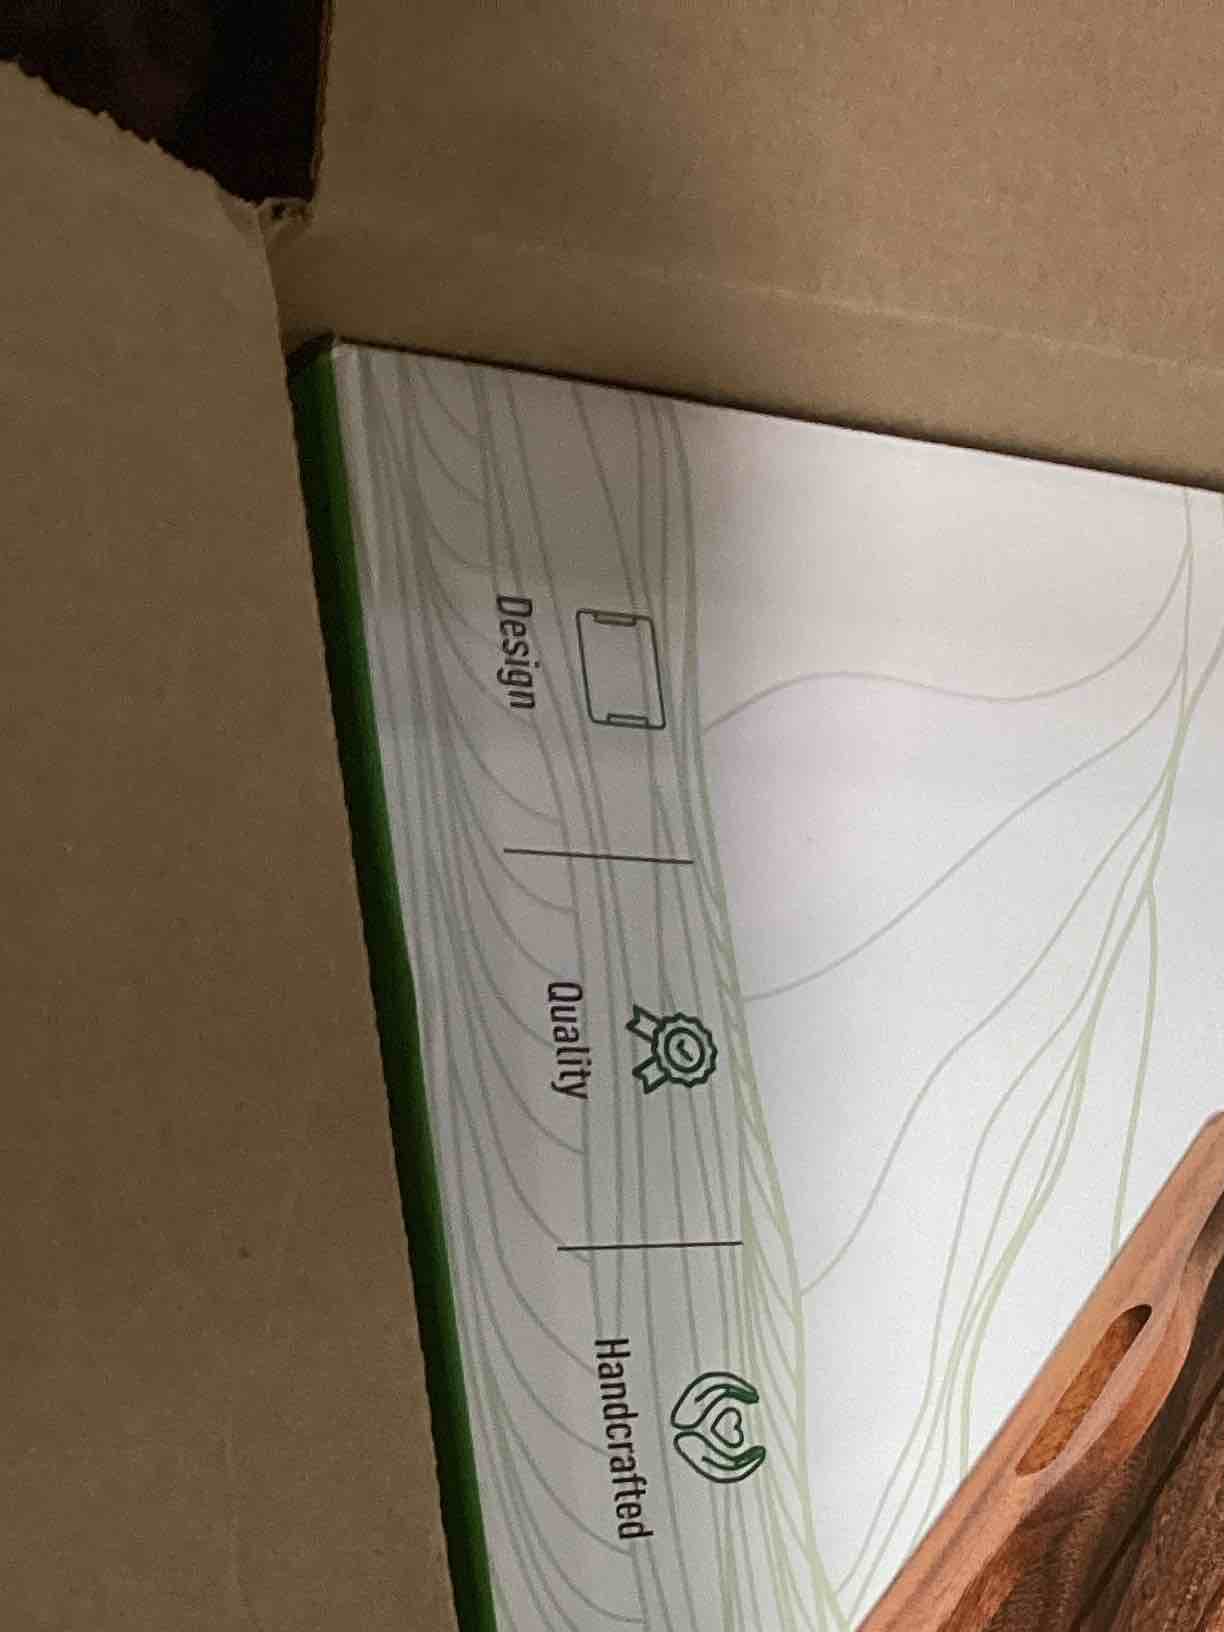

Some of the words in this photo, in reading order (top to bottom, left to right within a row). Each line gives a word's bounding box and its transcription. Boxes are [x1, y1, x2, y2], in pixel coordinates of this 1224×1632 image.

[495, 593, 538, 711] Design
[546, 981, 593, 1100] Quality
[593, 1336, 652, 1541] Handcrafted
